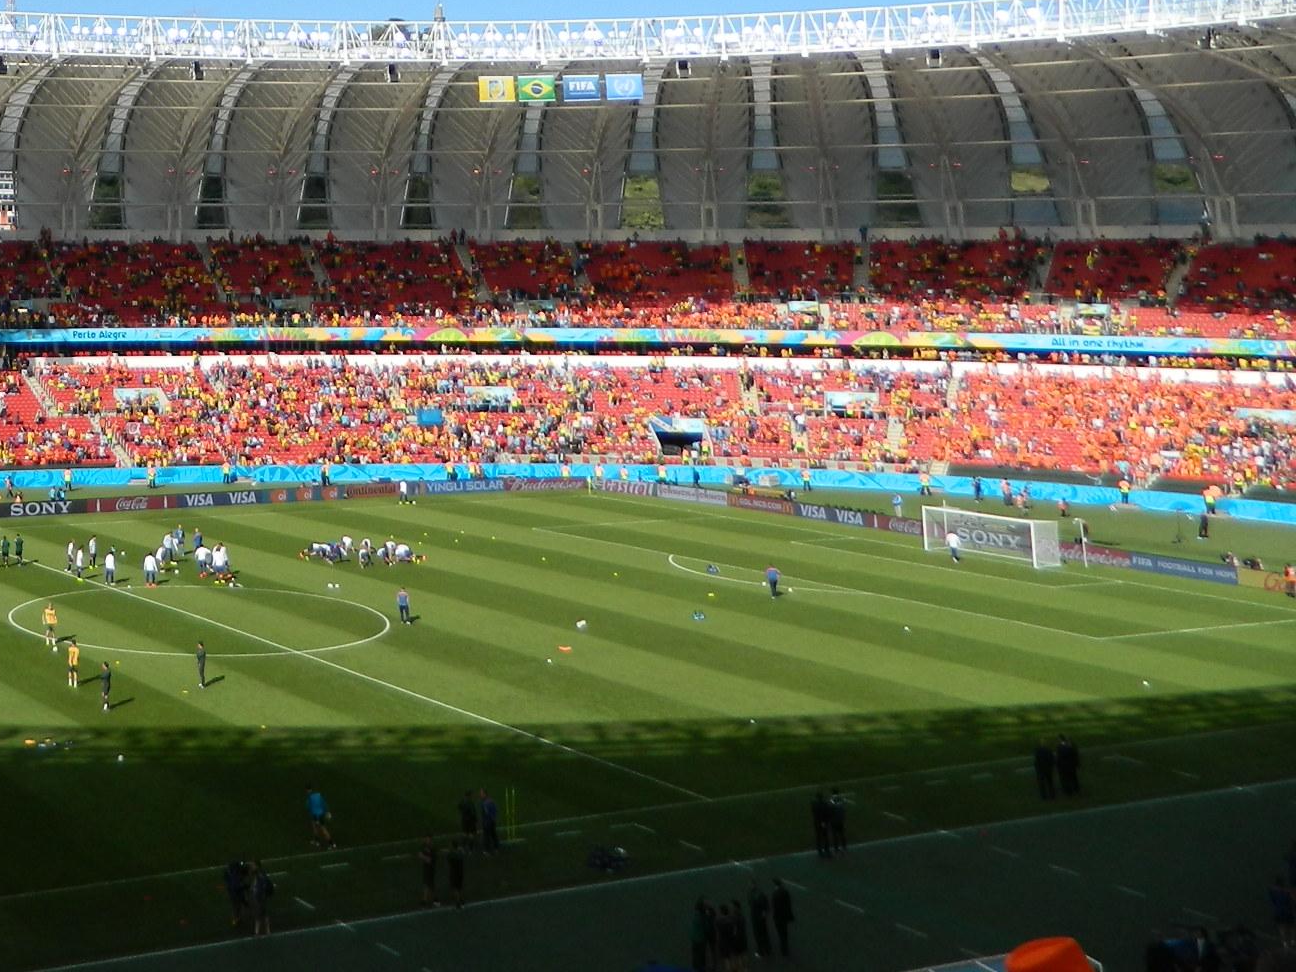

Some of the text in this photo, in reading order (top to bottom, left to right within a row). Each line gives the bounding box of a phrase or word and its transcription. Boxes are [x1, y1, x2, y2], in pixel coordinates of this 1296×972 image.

[569, 81, 595, 91] FIFA
[72, 330, 127, 340] Porto Alegre
[1051, 338, 1066, 347] All
[1069, 339, 1079, 347] in
[427, 479, 504, 492] YINGLI SOLAR
[185, 494, 214, 507] VISA
[227, 491, 256, 504] VISA
[10, 501, 72, 516] SONY
[800, 505, 826, 520] VISA
[835, 509, 864, 526] VISA
[956, 527, 1021, 548] SONY
[1132, 556, 1153, 567] FIFA
